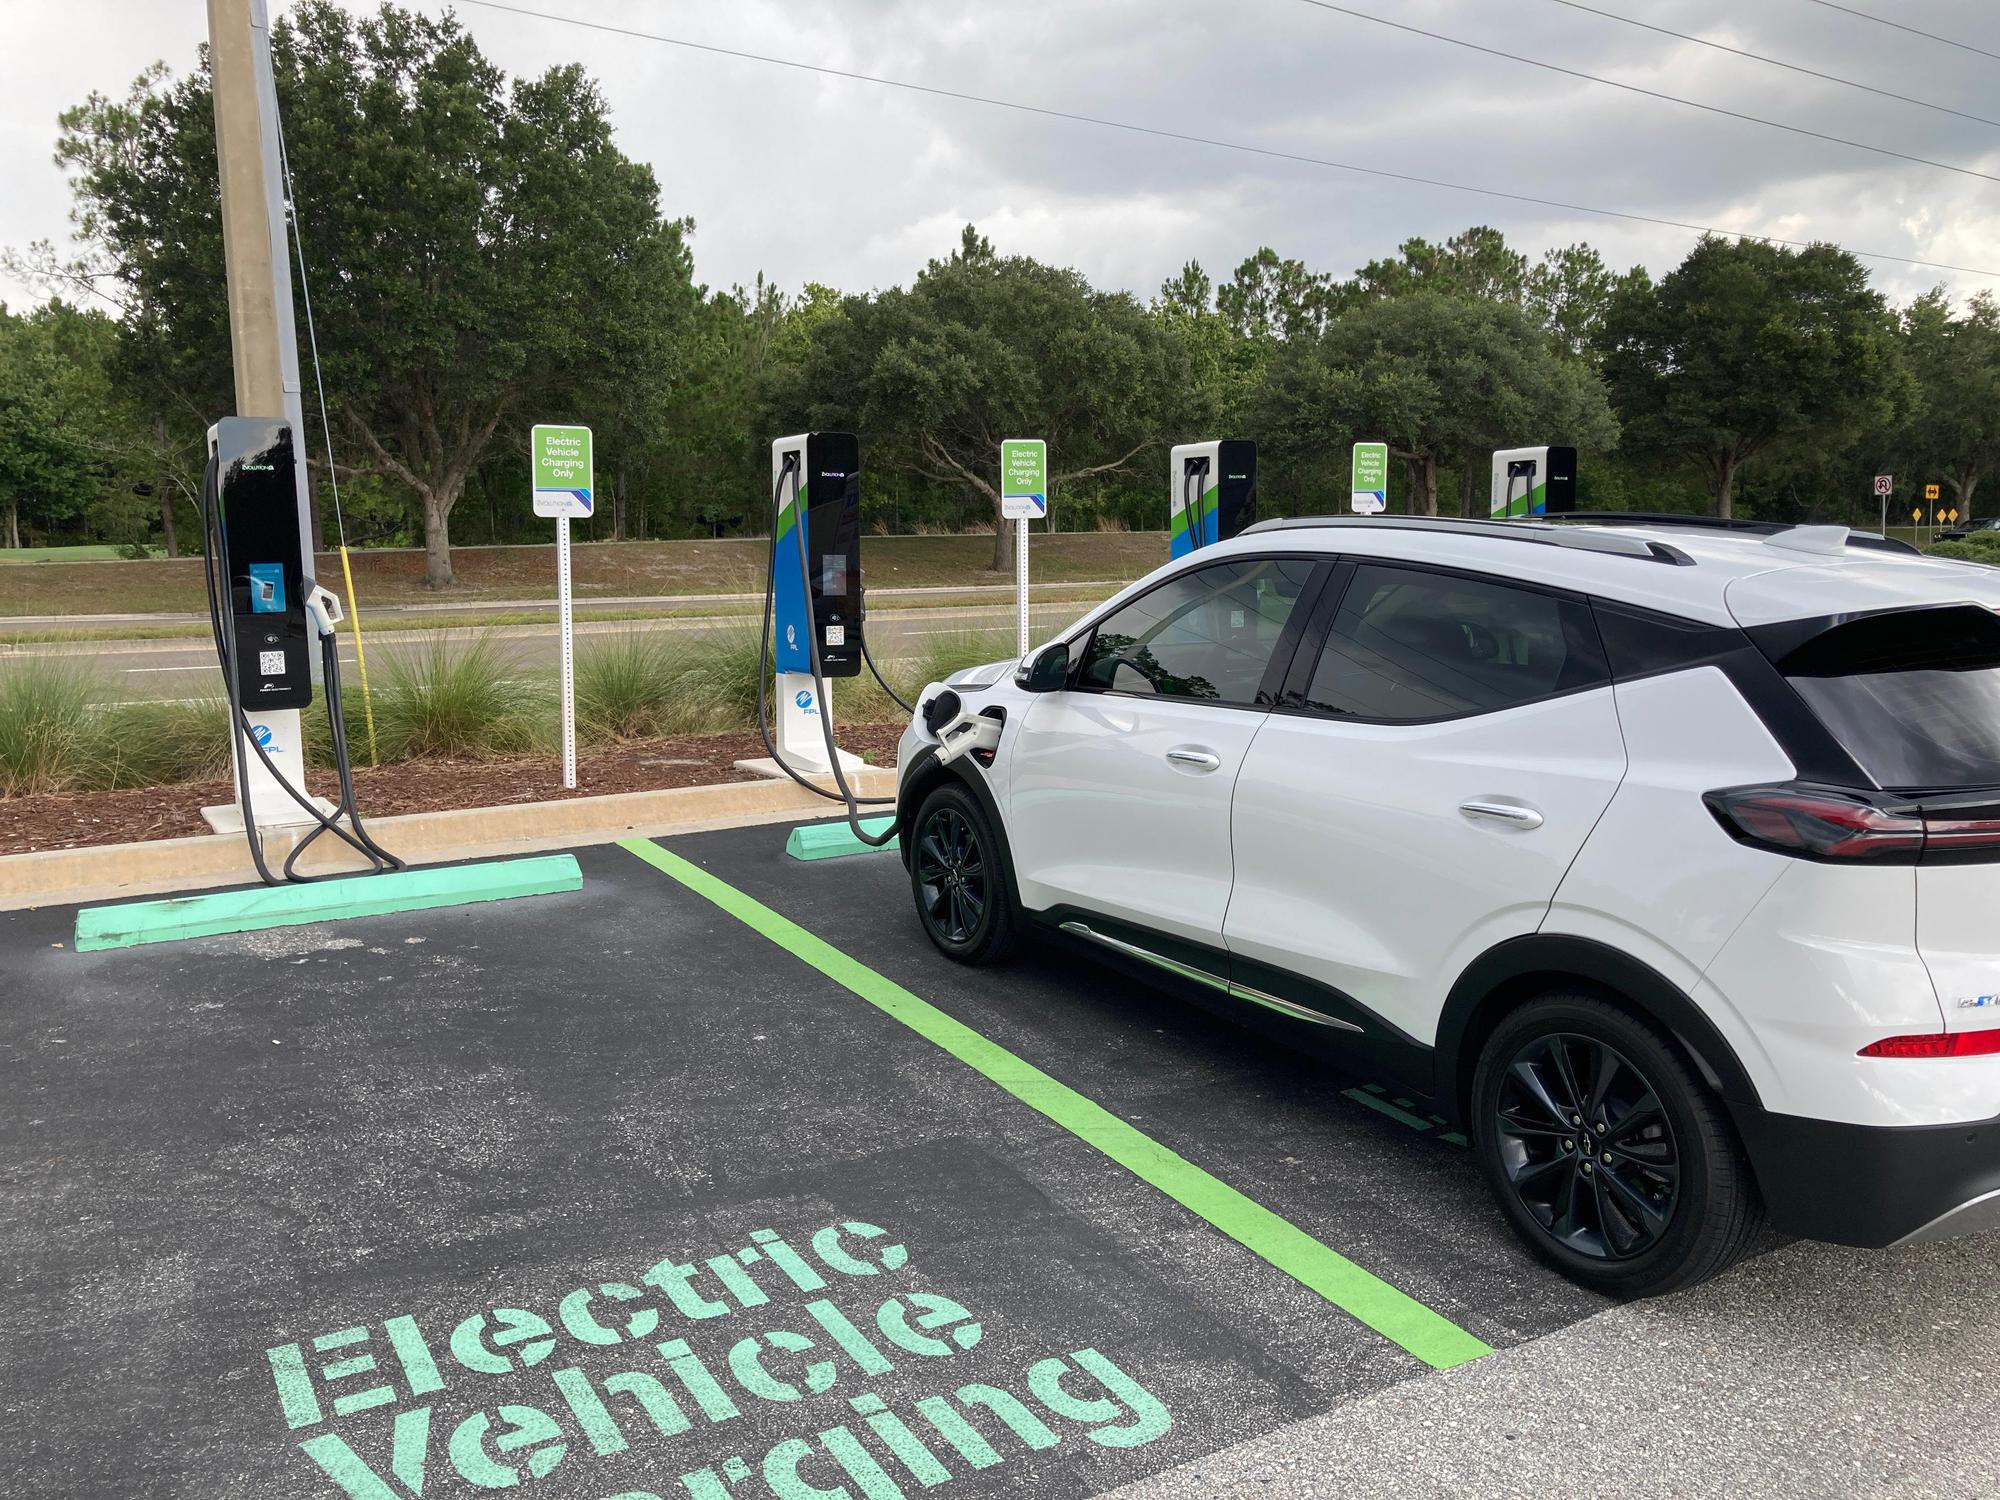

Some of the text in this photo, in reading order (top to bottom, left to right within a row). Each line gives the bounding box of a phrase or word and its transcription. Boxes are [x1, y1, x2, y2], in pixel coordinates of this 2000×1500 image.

[546, 436, 581, 446] Electric
[546, 447, 579, 457] Vehicle
[1011, 450, 1038, 458] Electric
[541, 457, 584, 469] Charging
[1011, 459, 1037, 467] Vehicle
[552, 468, 574, 479] Only
[1008, 468, 1040, 477] Charging
[1016, 477, 1033, 486] Only
[267, 1222, 908, 1429] Electric
[300, 1292, 982, 1500] Vehicle
